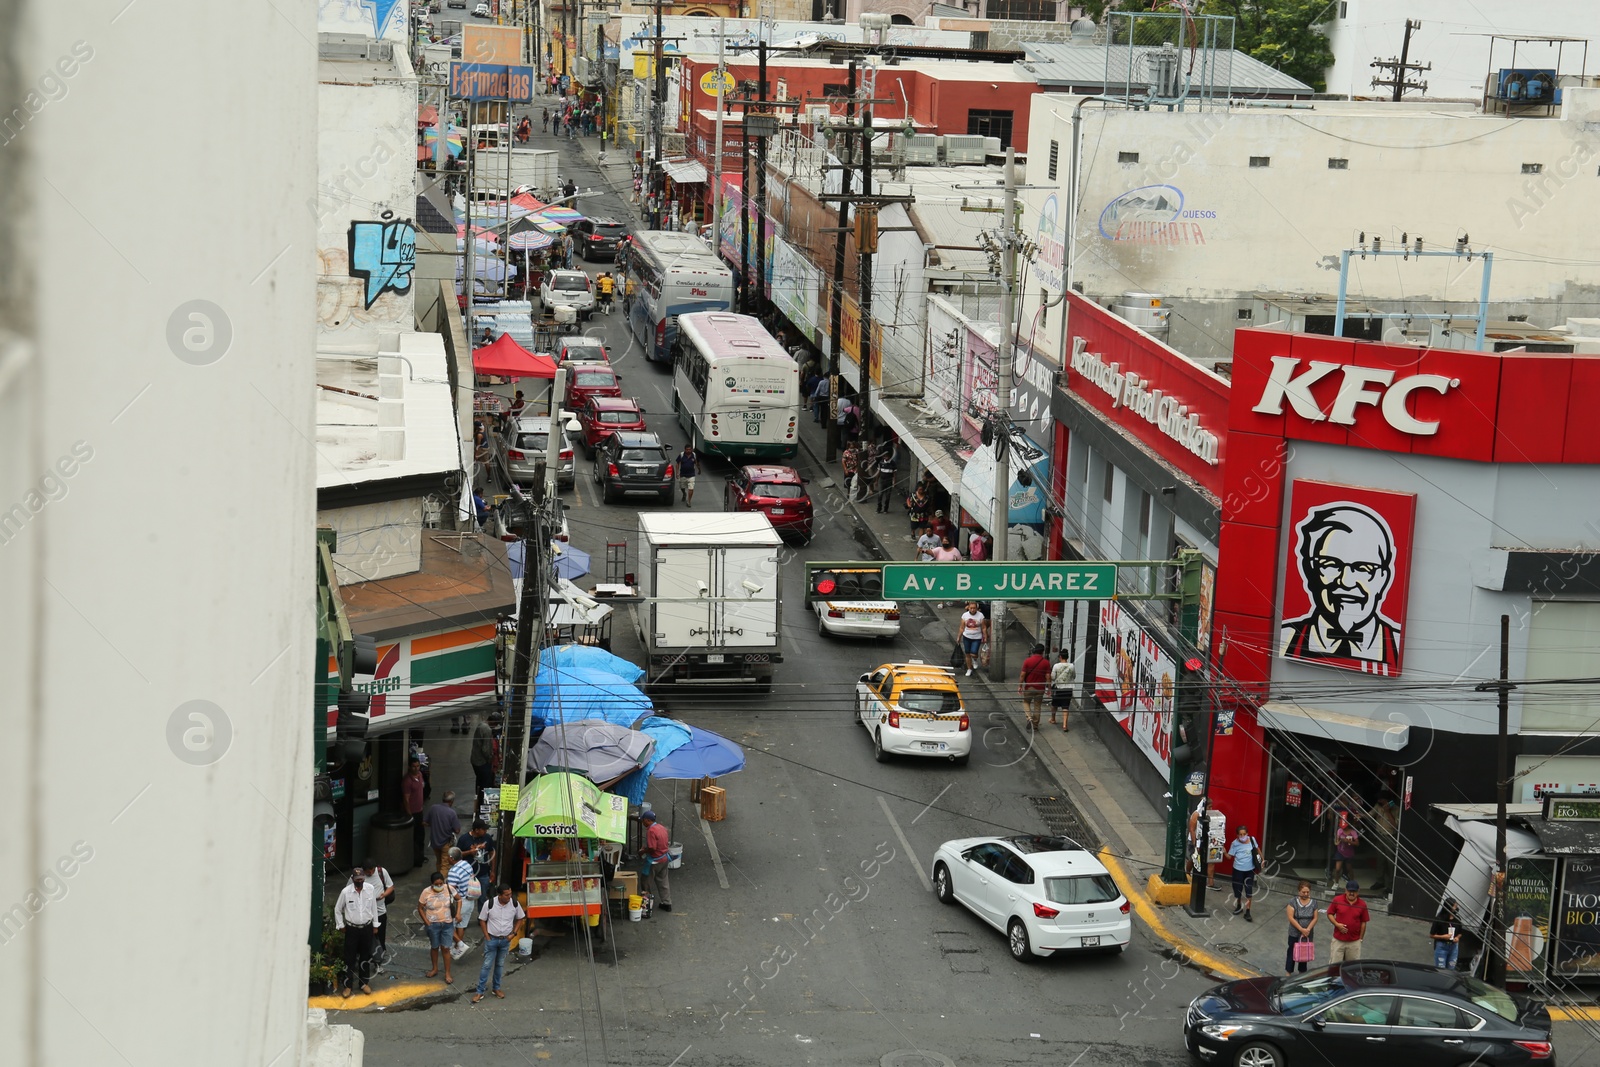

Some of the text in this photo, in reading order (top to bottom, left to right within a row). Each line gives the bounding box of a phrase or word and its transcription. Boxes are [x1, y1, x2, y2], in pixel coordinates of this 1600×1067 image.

[452, 65, 530, 99] Farmacias
[702, 82, 732, 90] CAROS
[1182, 210, 1217, 219] QUESOS
[1070, 336, 1126, 408] Kentucky
[1123, 371, 1163, 424] Fried
[1251, 355, 1453, 435] KFC
[743, 412, 766, 420] R-301
[1158, 396, 1219, 466] Chicken
[903, 572, 1099, 591] Av. B. JUAREZ
[1557, 808, 1579, 817] EKOS
[1572, 864, 1592, 872] EKOS
